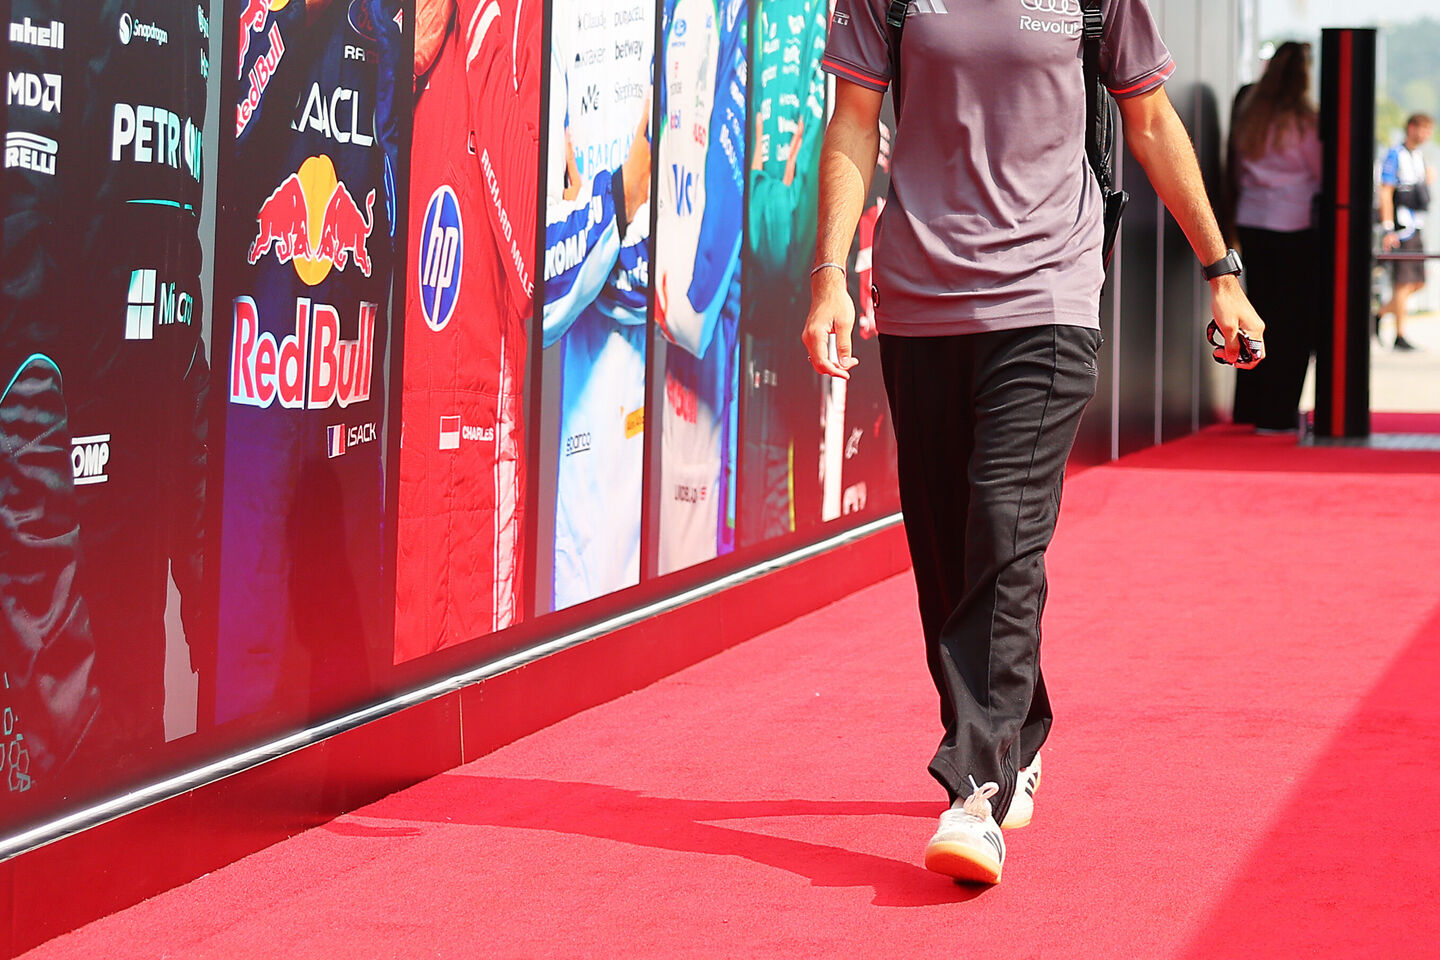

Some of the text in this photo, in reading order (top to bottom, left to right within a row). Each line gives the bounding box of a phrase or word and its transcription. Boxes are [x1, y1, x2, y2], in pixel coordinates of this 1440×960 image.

[133, 19, 168, 46] Snapdragon
[615, 38, 644, 62] betway
[480, 148, 534, 299] RICHARD MILLE
[347, 422, 377, 448] ISACK
[462, 424, 494, 442] CHARLES
[71, 442, 110, 478] OMP
